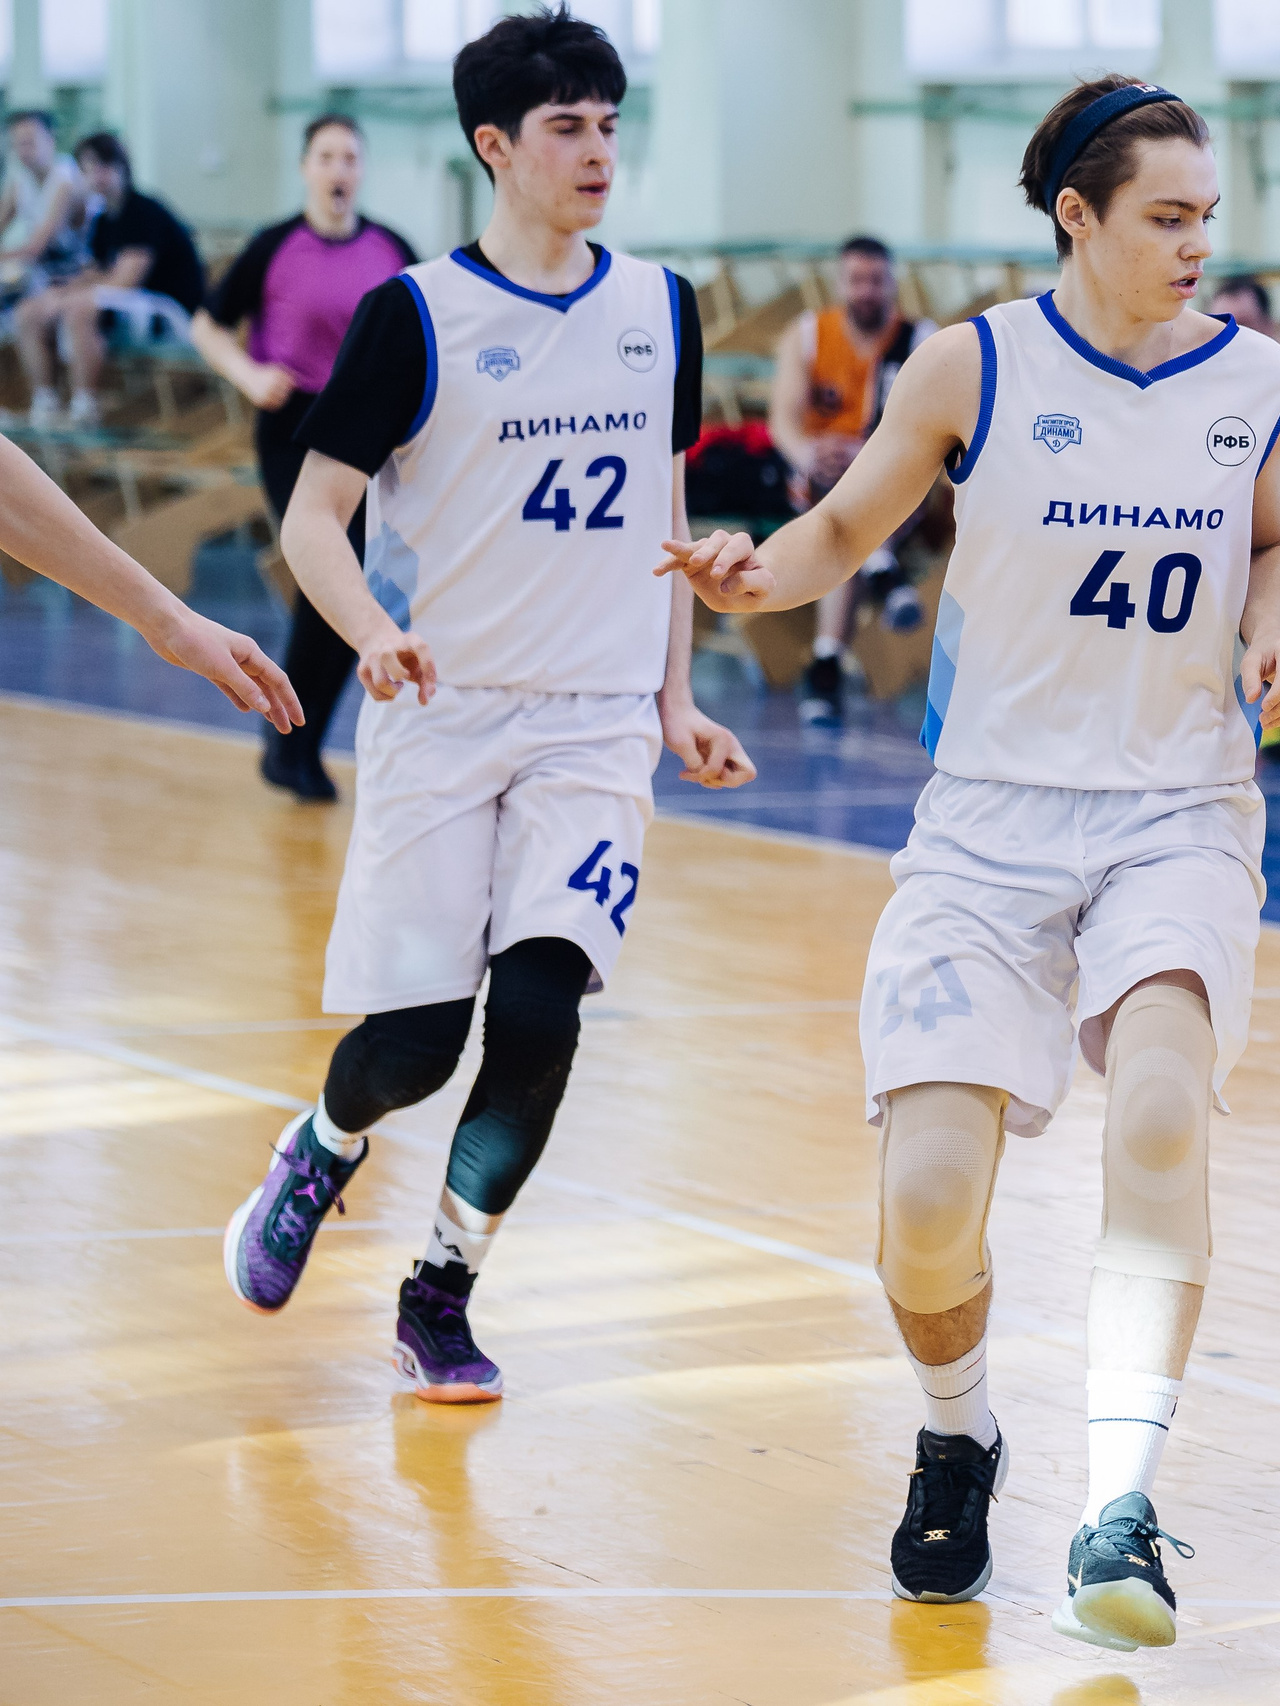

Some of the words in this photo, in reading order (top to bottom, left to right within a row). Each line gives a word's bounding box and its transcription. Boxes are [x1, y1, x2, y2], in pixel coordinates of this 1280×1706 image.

[623, 342, 653, 357] РФБ
[498, 411, 647, 444] ДИНАМО
[1040, 426, 1075, 438] ДИНАМО
[1213, 433, 1250, 449] РФБ
[521, 454, 627, 533] 42
[1042, 500, 1224, 531] ДИНАМО
[1069, 549, 1203, 634] 40
[567, 840, 639, 938] 42
